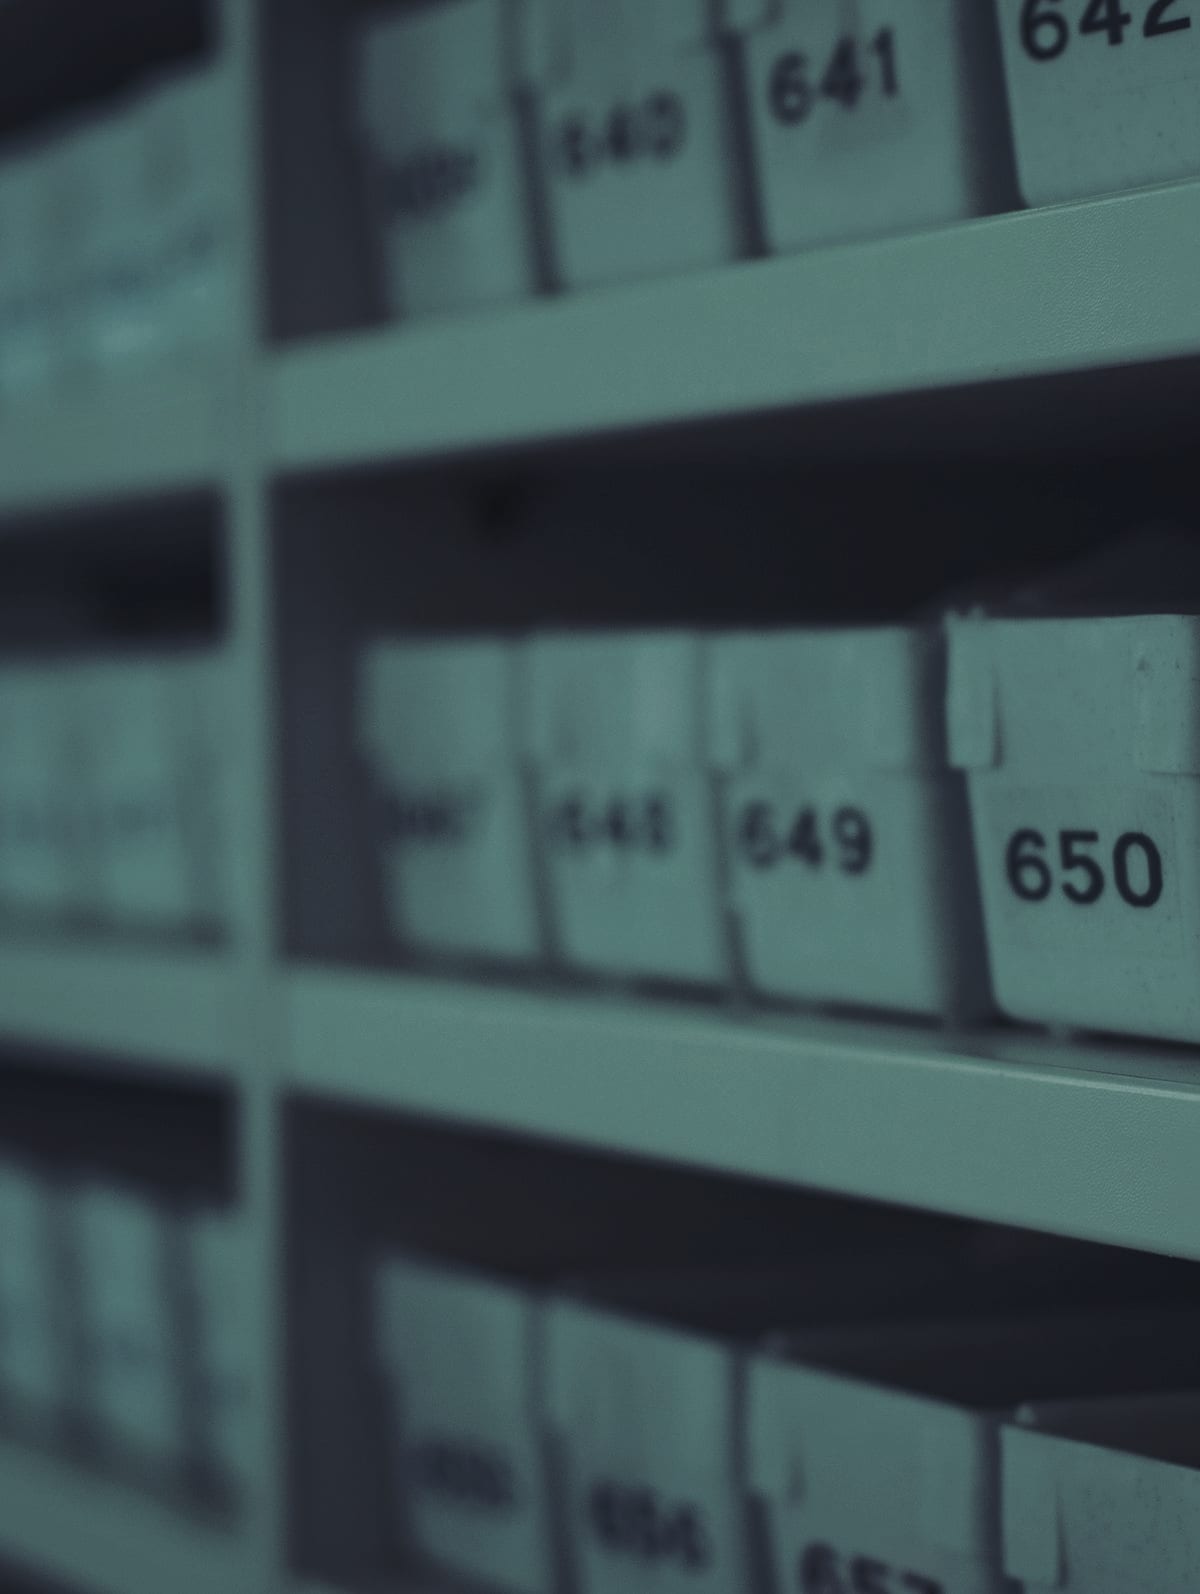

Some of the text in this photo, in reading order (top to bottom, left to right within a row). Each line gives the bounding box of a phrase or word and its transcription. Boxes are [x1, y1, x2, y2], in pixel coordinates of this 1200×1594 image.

[1019, 0, 1191, 62] 642
[769, 26, 898, 127] 641
[737, 800, 874, 876] 649
[1005, 828, 1164, 908] 650
